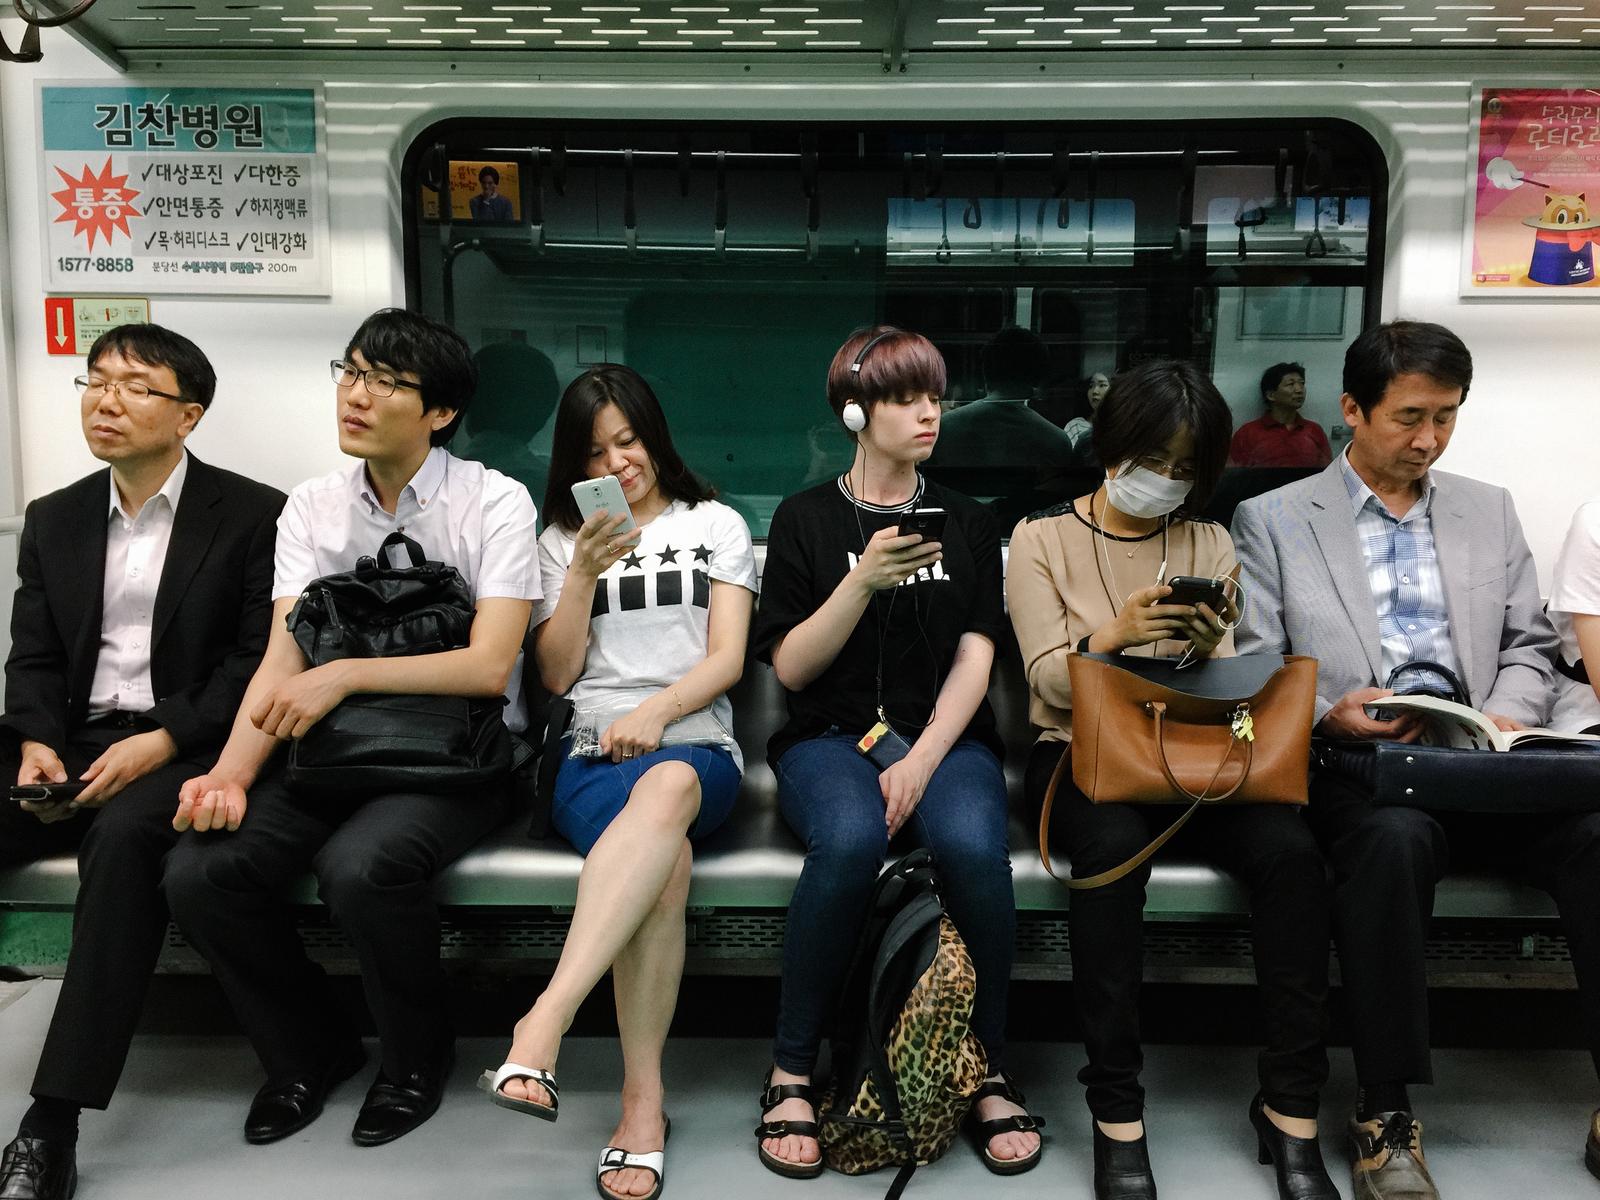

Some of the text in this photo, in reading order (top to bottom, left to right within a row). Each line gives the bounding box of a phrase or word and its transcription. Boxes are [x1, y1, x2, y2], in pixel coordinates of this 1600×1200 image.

[93, 102, 264, 149] 김찬병원
[156, 164, 223, 185] 대상포진
[249, 165, 301, 187] 다한증
[71, 187, 127, 219] 통증
[156, 197, 224, 219] 안면통증
[250, 198, 308, 220] 하지정맥류
[250, 232, 307, 253] 인대강화
[151, 262, 179, 273] 분당선
[267, 262, 297, 273] 200m
